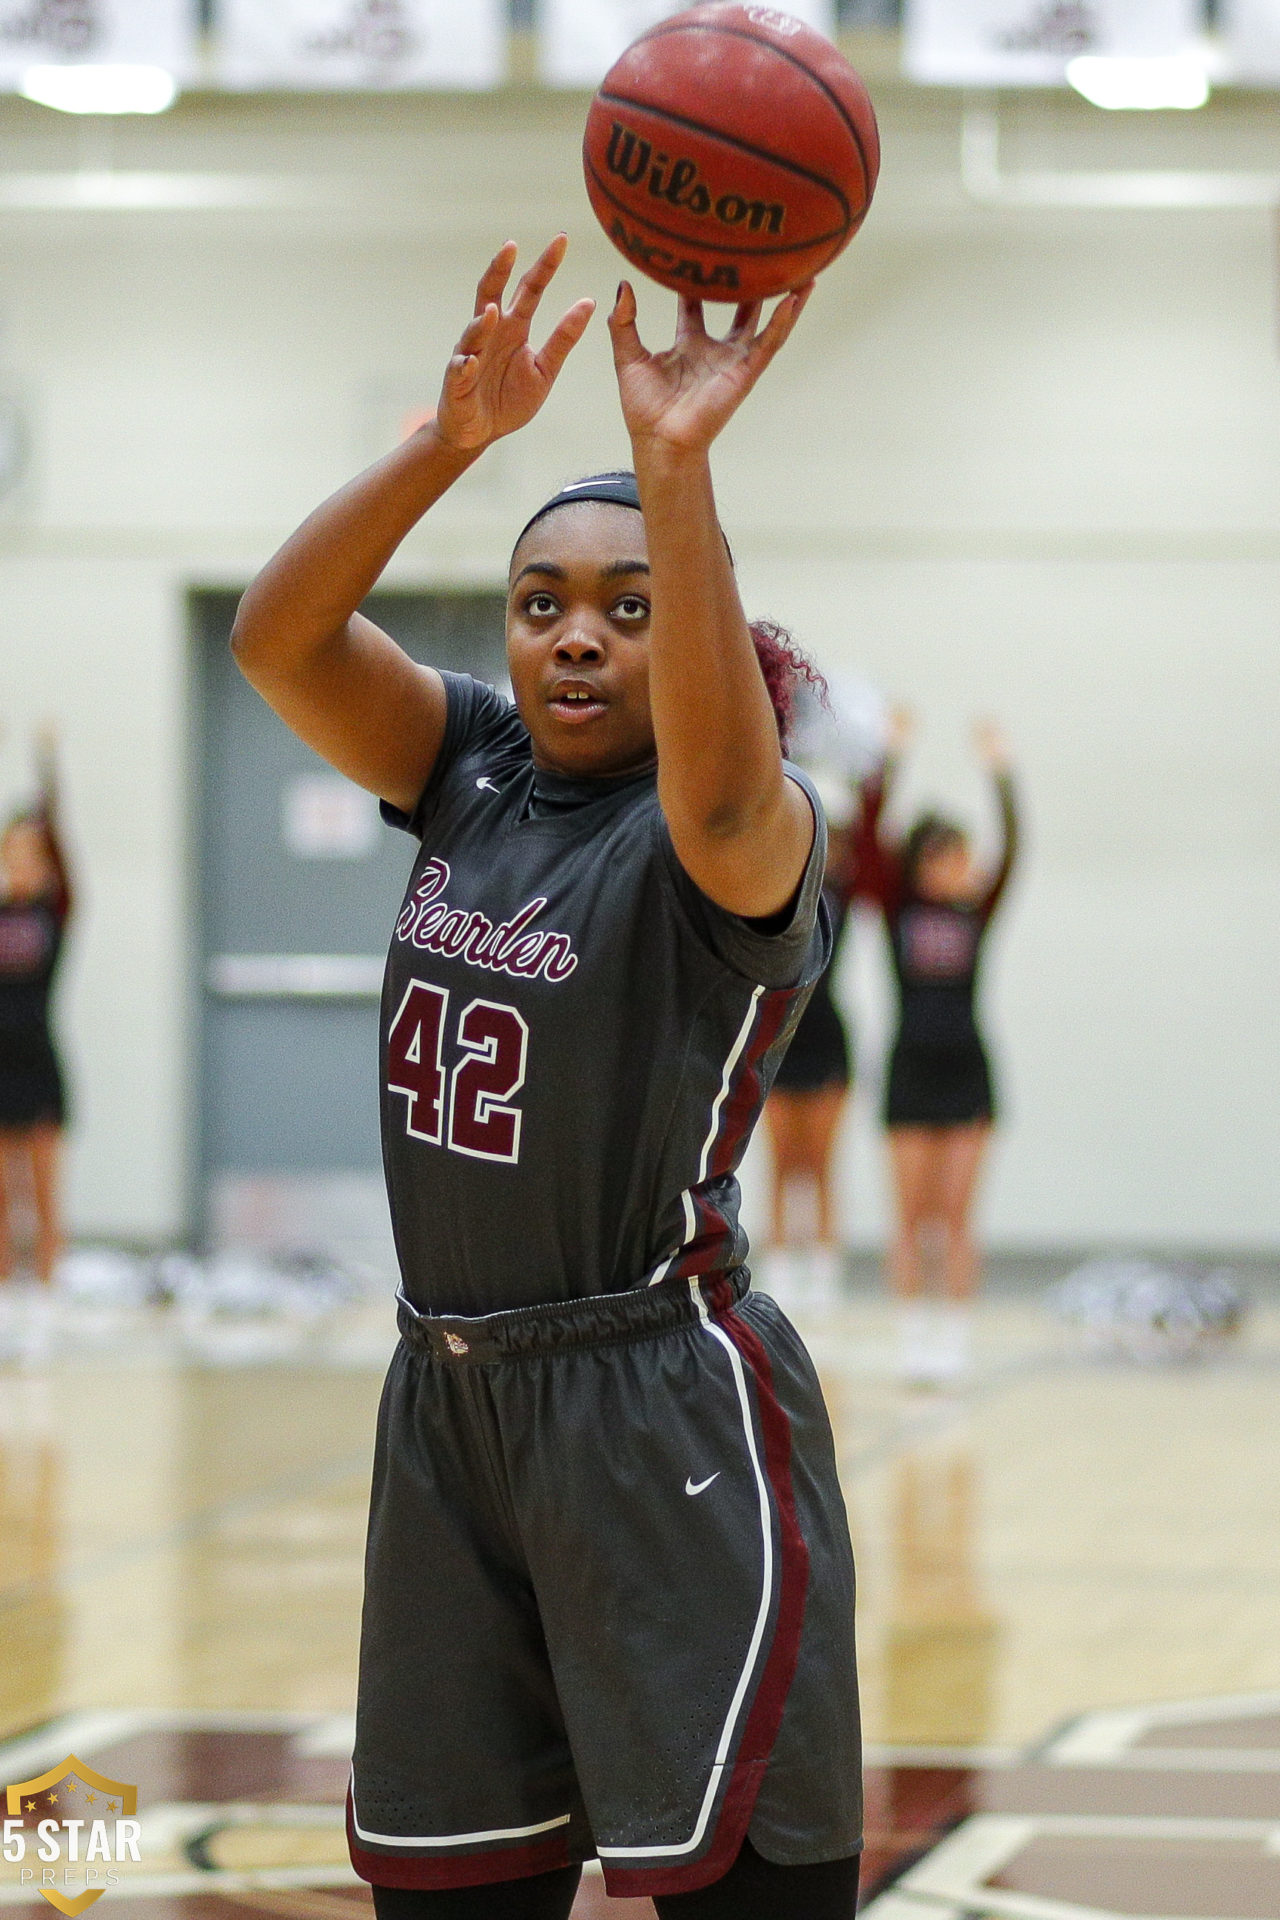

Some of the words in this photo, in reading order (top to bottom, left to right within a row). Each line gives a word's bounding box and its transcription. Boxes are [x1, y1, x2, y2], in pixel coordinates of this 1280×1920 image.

[606, 121, 784, 235] Wilson
[610, 217, 741, 290] NCAA
[396, 857, 578, 982] Bearden
[388, 978, 529, 1164] 42
